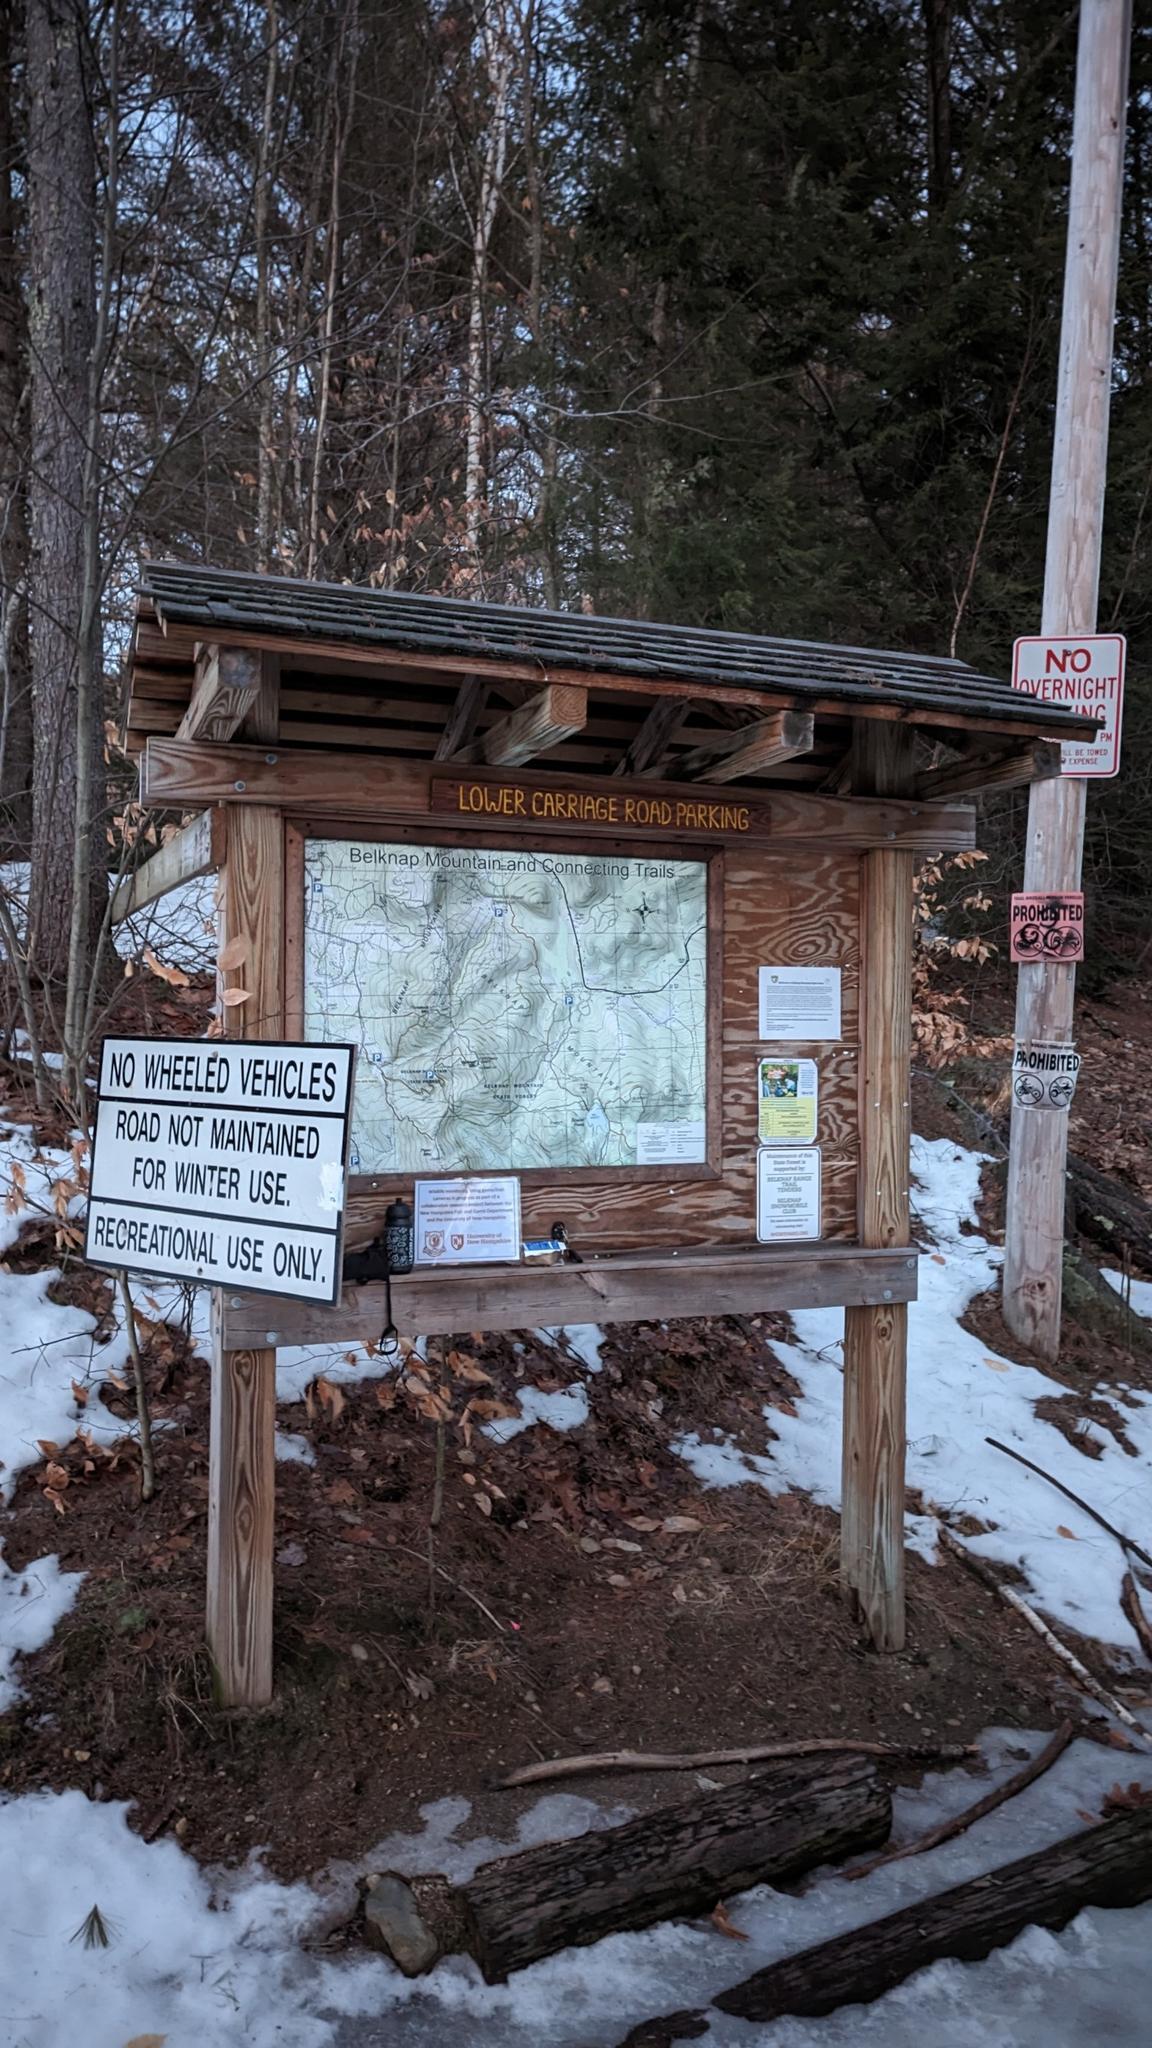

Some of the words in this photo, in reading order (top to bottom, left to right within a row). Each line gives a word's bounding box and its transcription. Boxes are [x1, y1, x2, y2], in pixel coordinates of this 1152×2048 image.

[1045, 649, 1092, 673] NO
[1019, 677, 1117, 700] OVERNIGHT
[1075, 749, 1085, 757] BE
[1100, 732, 1112, 742] PM
[459, 785, 526, 815] LOWER
[532, 791, 618, 822] CARRIAGE
[625, 799, 671, 825] ROAD
[676, 803, 749, 830] PARKING
[350, 847, 419, 868] Belknap
[426, 852, 500, 870] Mountain
[506, 858, 536, 872] and
[542, 858, 629, 879] Connecting
[634, 863, 675, 879] Trails
[109, 1053, 135, 1088] NO
[144, 1054, 230, 1093] WHEELED
[240, 1058, 337, 1102] VEHICLES
[115, 1110, 161, 1142] ROAD
[168, 1114, 203, 1148] NOT
[210, 1118, 320, 1160] MAINTAINED
[133, 1157, 166, 1190] FOR
[175, 1162, 241, 1200] WINTER
[249, 1170, 290, 1207] USE.
[95, 1216, 218, 1265] RECREATIONAL
[227, 1235, 264, 1273] USE
[273, 1242, 326, 1283] ONLY.
